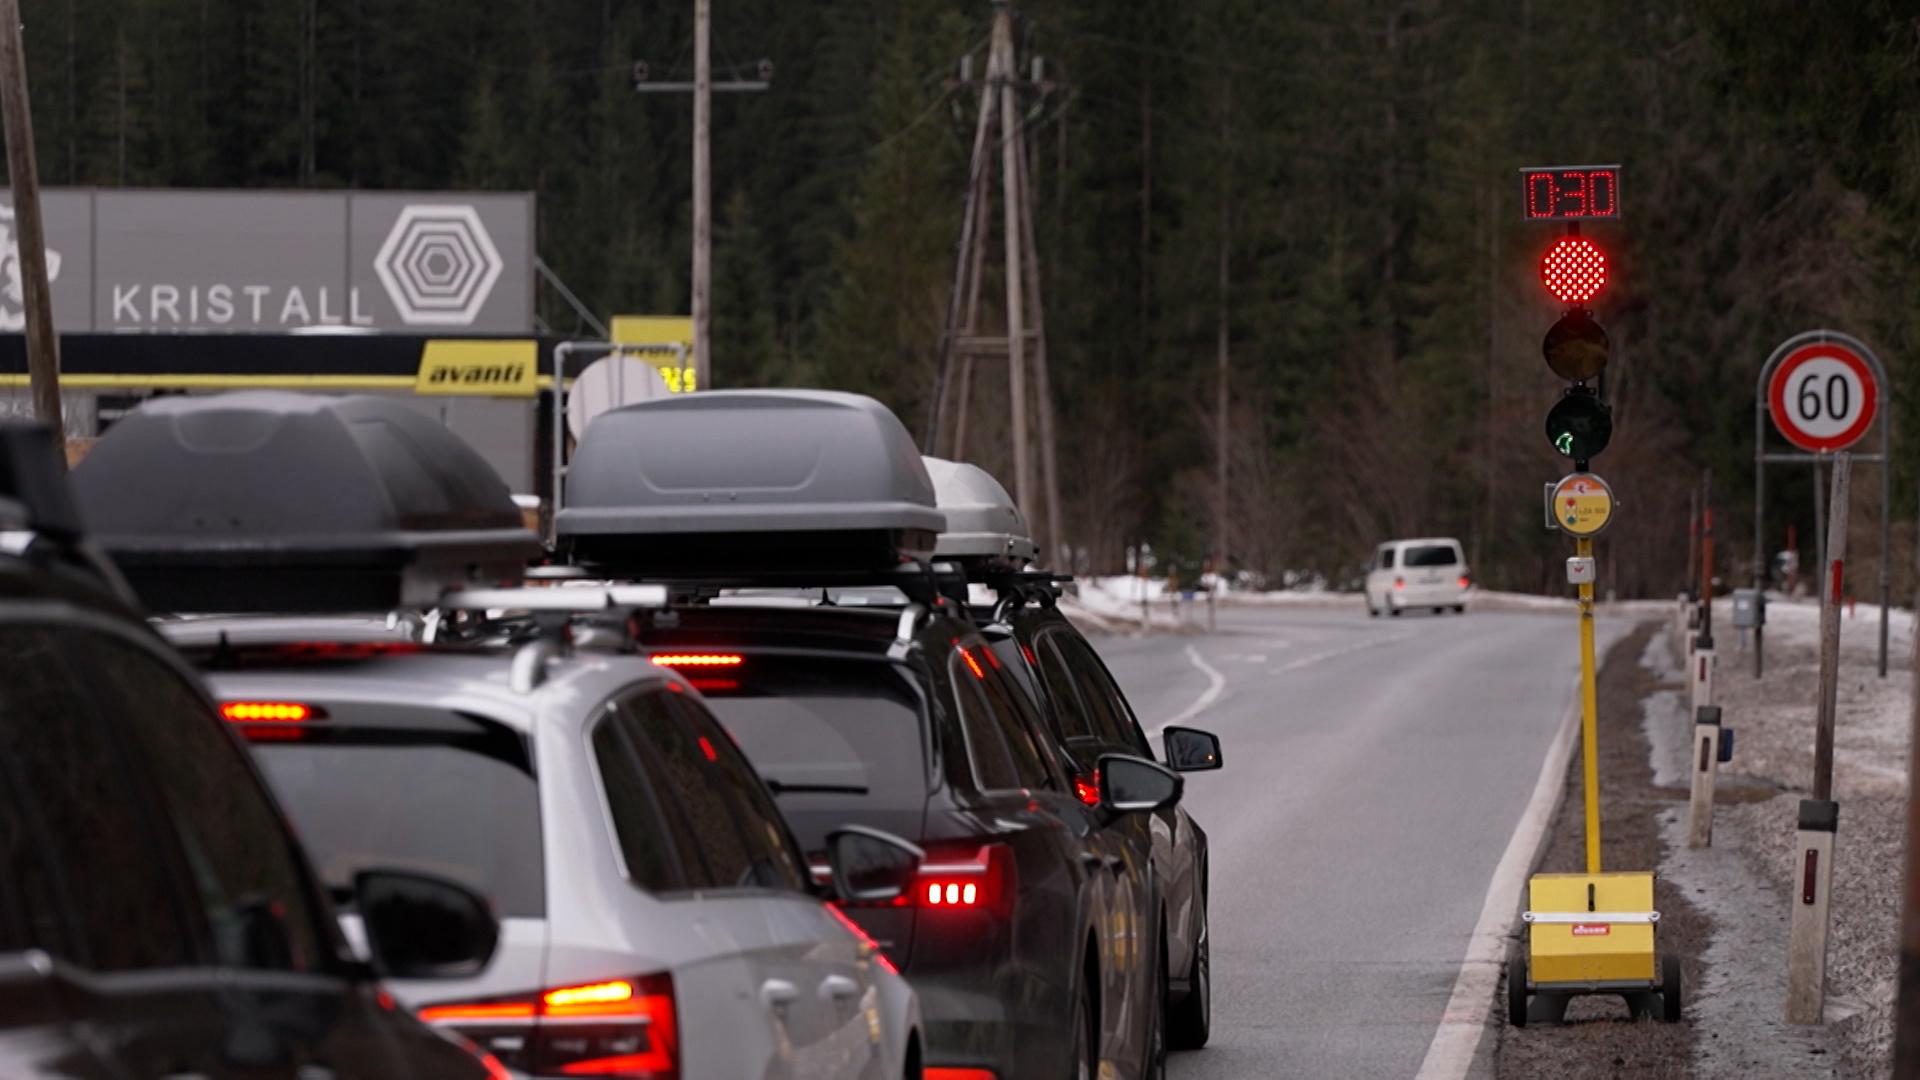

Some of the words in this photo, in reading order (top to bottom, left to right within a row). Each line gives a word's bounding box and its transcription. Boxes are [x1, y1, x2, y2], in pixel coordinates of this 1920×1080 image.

[1529, 170, 1613, 217] 0:30
[113, 285, 374, 324] KRISTALL
[429, 362, 526, 384] avanti
[1798, 373, 1849, 420] 60
